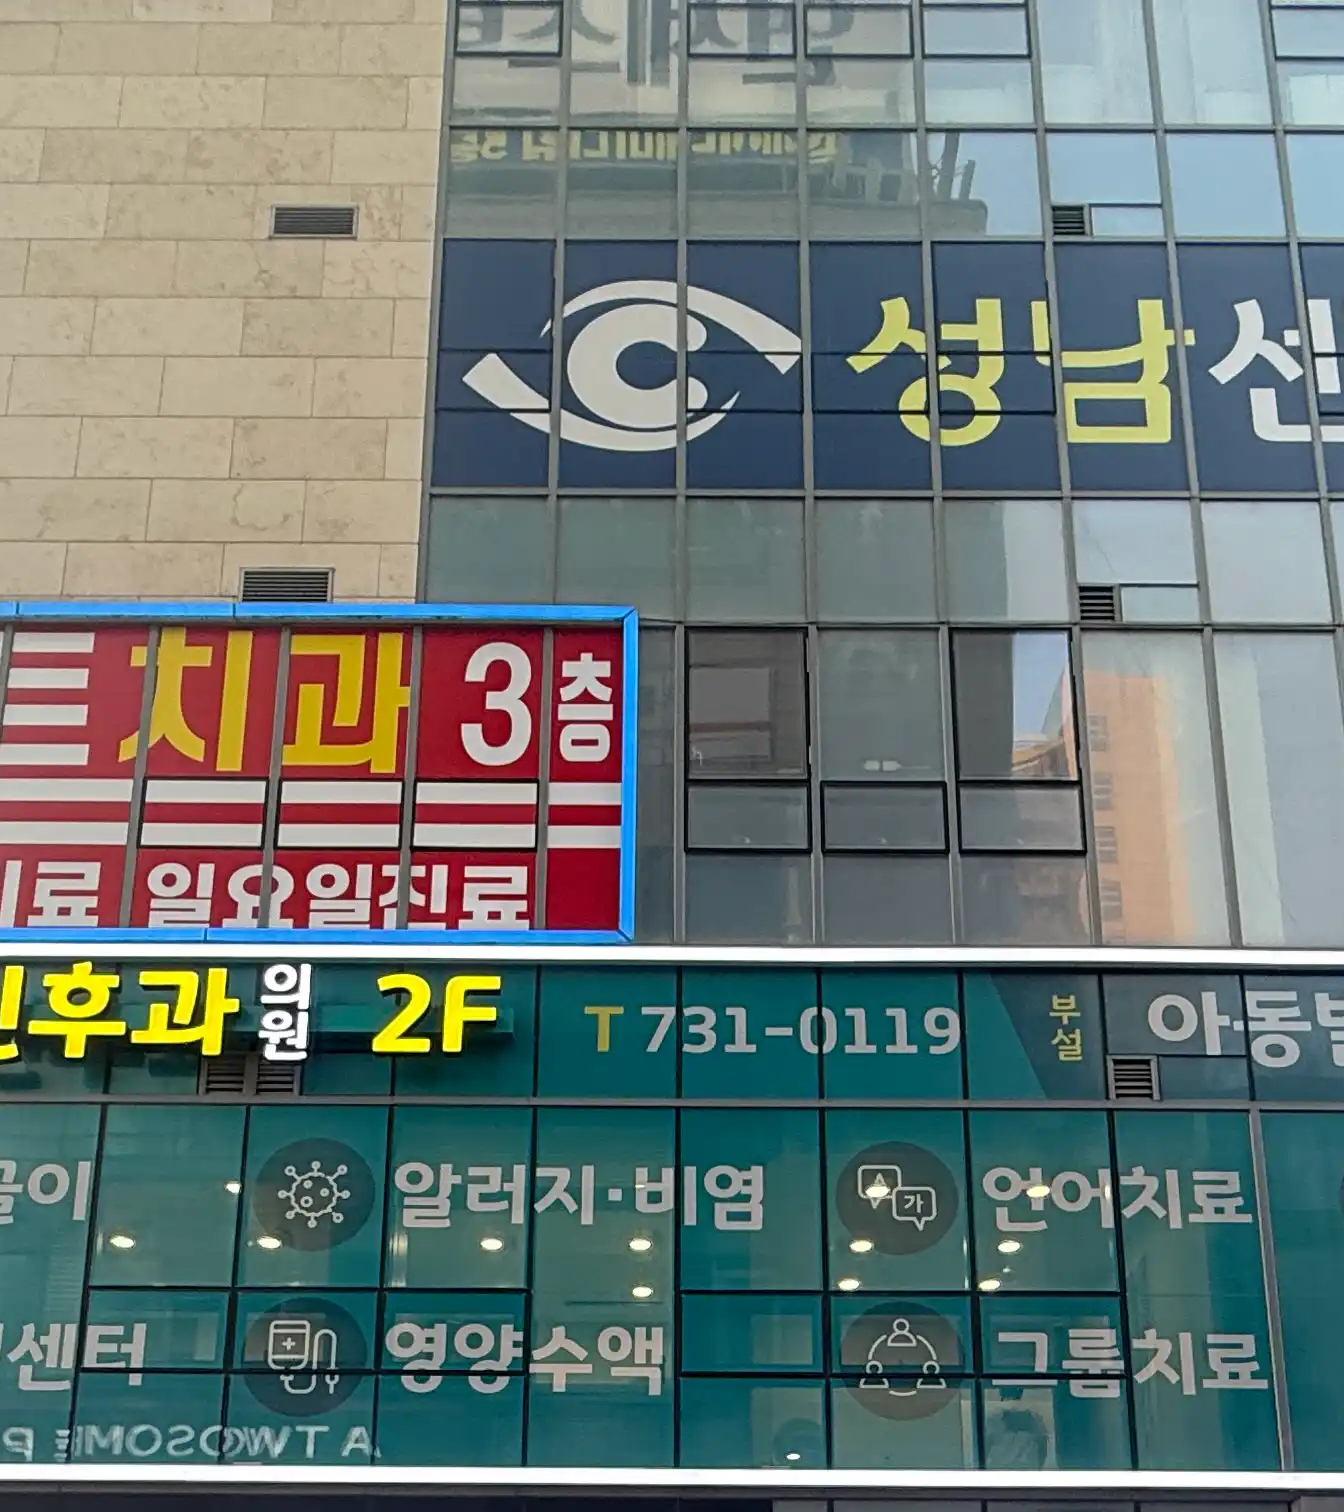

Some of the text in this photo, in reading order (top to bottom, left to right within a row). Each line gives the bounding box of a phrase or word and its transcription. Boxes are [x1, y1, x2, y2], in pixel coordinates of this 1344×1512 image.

[461, 642, 614, 767] 3층
[147, 862, 529, 930] 일요일진료
[372, 973, 503, 1054] 2F
[585, 1005, 961, 1055] T 731-0119
[1049, 994, 1084, 1062] 부설
[982, 1165, 1254, 1233] 언어치료
[385, 1321, 665, 1396] 영양수액
[991, 1328, 1270, 1398] 그룹치료
